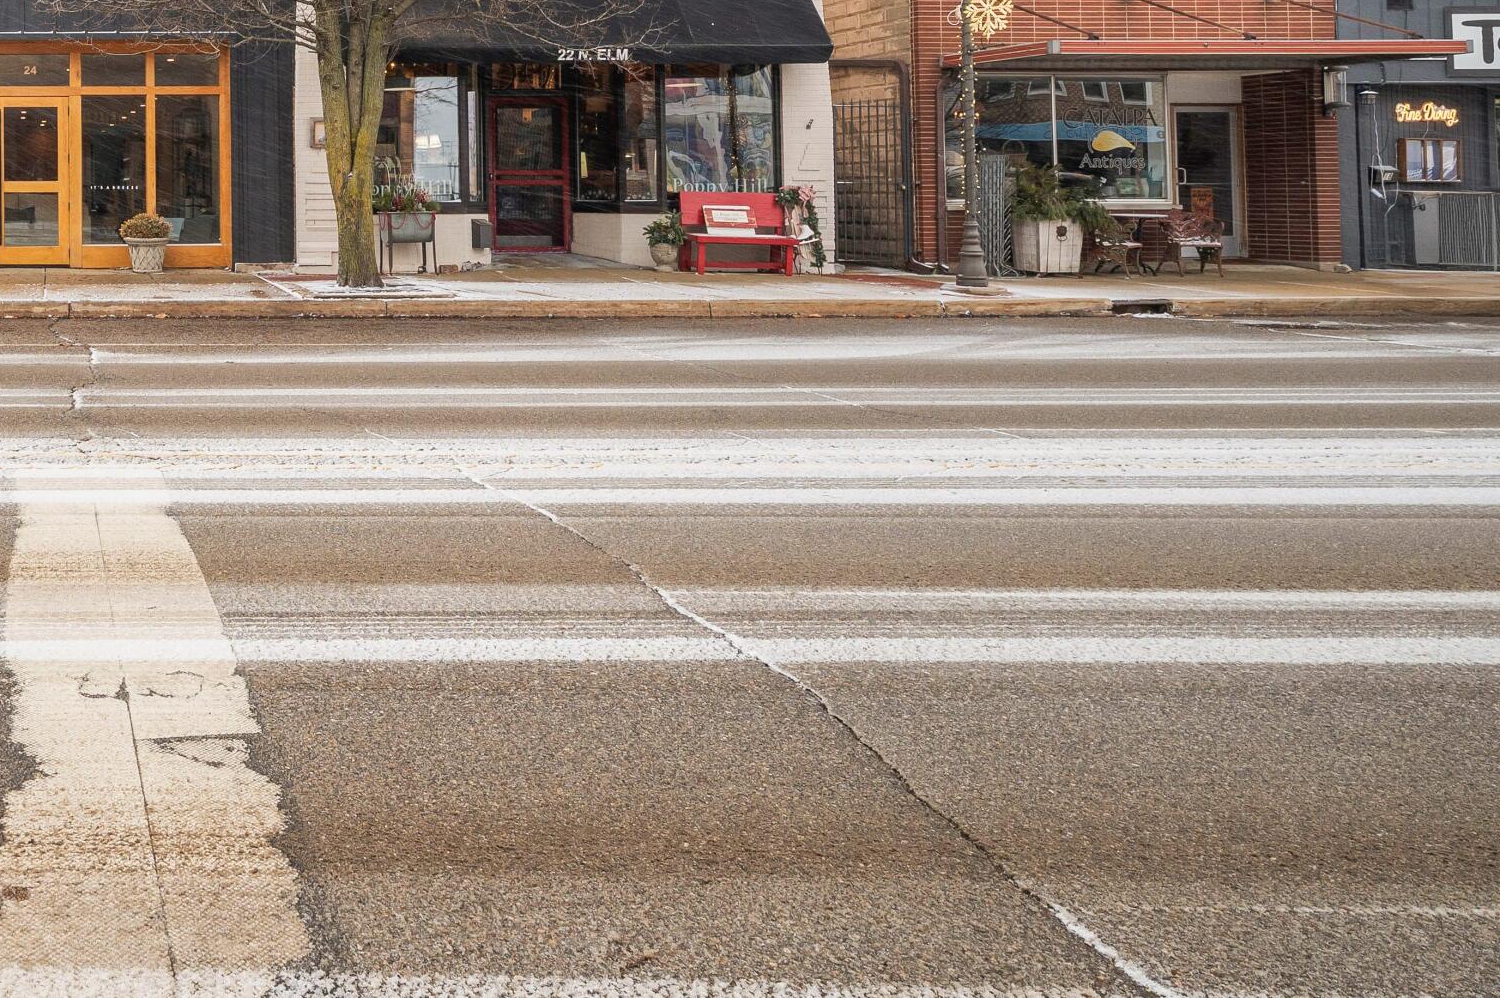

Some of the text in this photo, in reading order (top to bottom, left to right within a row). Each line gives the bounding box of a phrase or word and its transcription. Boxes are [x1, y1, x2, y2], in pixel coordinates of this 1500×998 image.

[557, 48, 629, 61] 22 N. ELM
[23, 65, 37, 75] 24
[1395, 102, 1422, 122] Fine
[1079, 152, 1146, 175] Antiques
[735, 177, 768, 193] Hill
